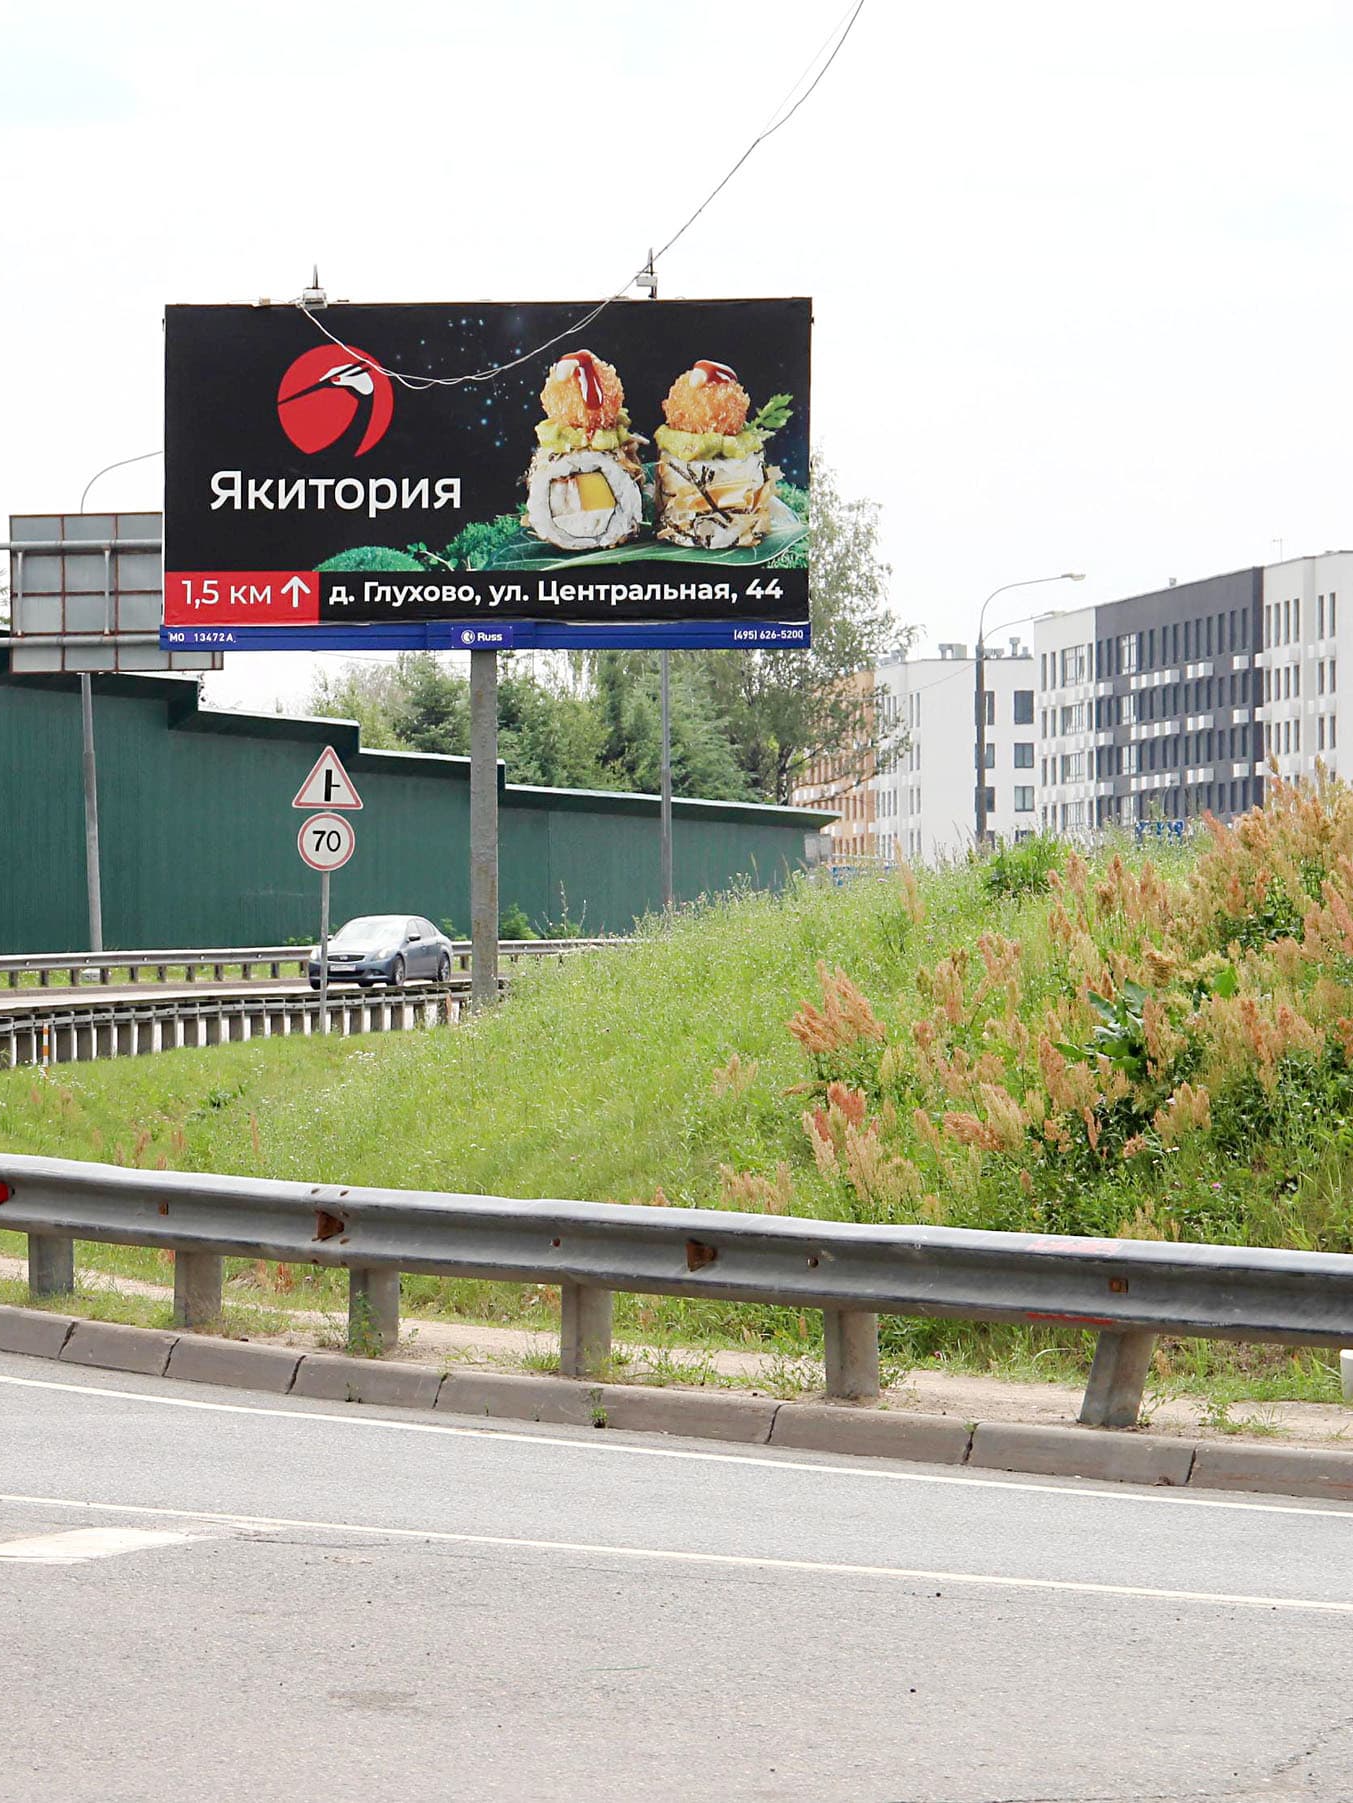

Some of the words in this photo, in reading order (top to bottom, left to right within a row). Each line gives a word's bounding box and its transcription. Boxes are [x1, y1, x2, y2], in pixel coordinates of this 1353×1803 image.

[210, 470, 461, 518] Якитория
[181, 579, 220, 609] 1,5
[230, 585, 272, 605] км
[329, 585, 355, 606] д.
[364, 581, 482, 607] Глухово,
[488, 584, 530, 607] ул.
[538, 580, 738, 606] Центральная,
[745, 578, 784, 600] 44
[477, 632, 503, 642] Russ
[734, 629, 758, 641] (495)
[760, 629, 804, 640] 626-5200
[312, 830, 341, 852] 70
